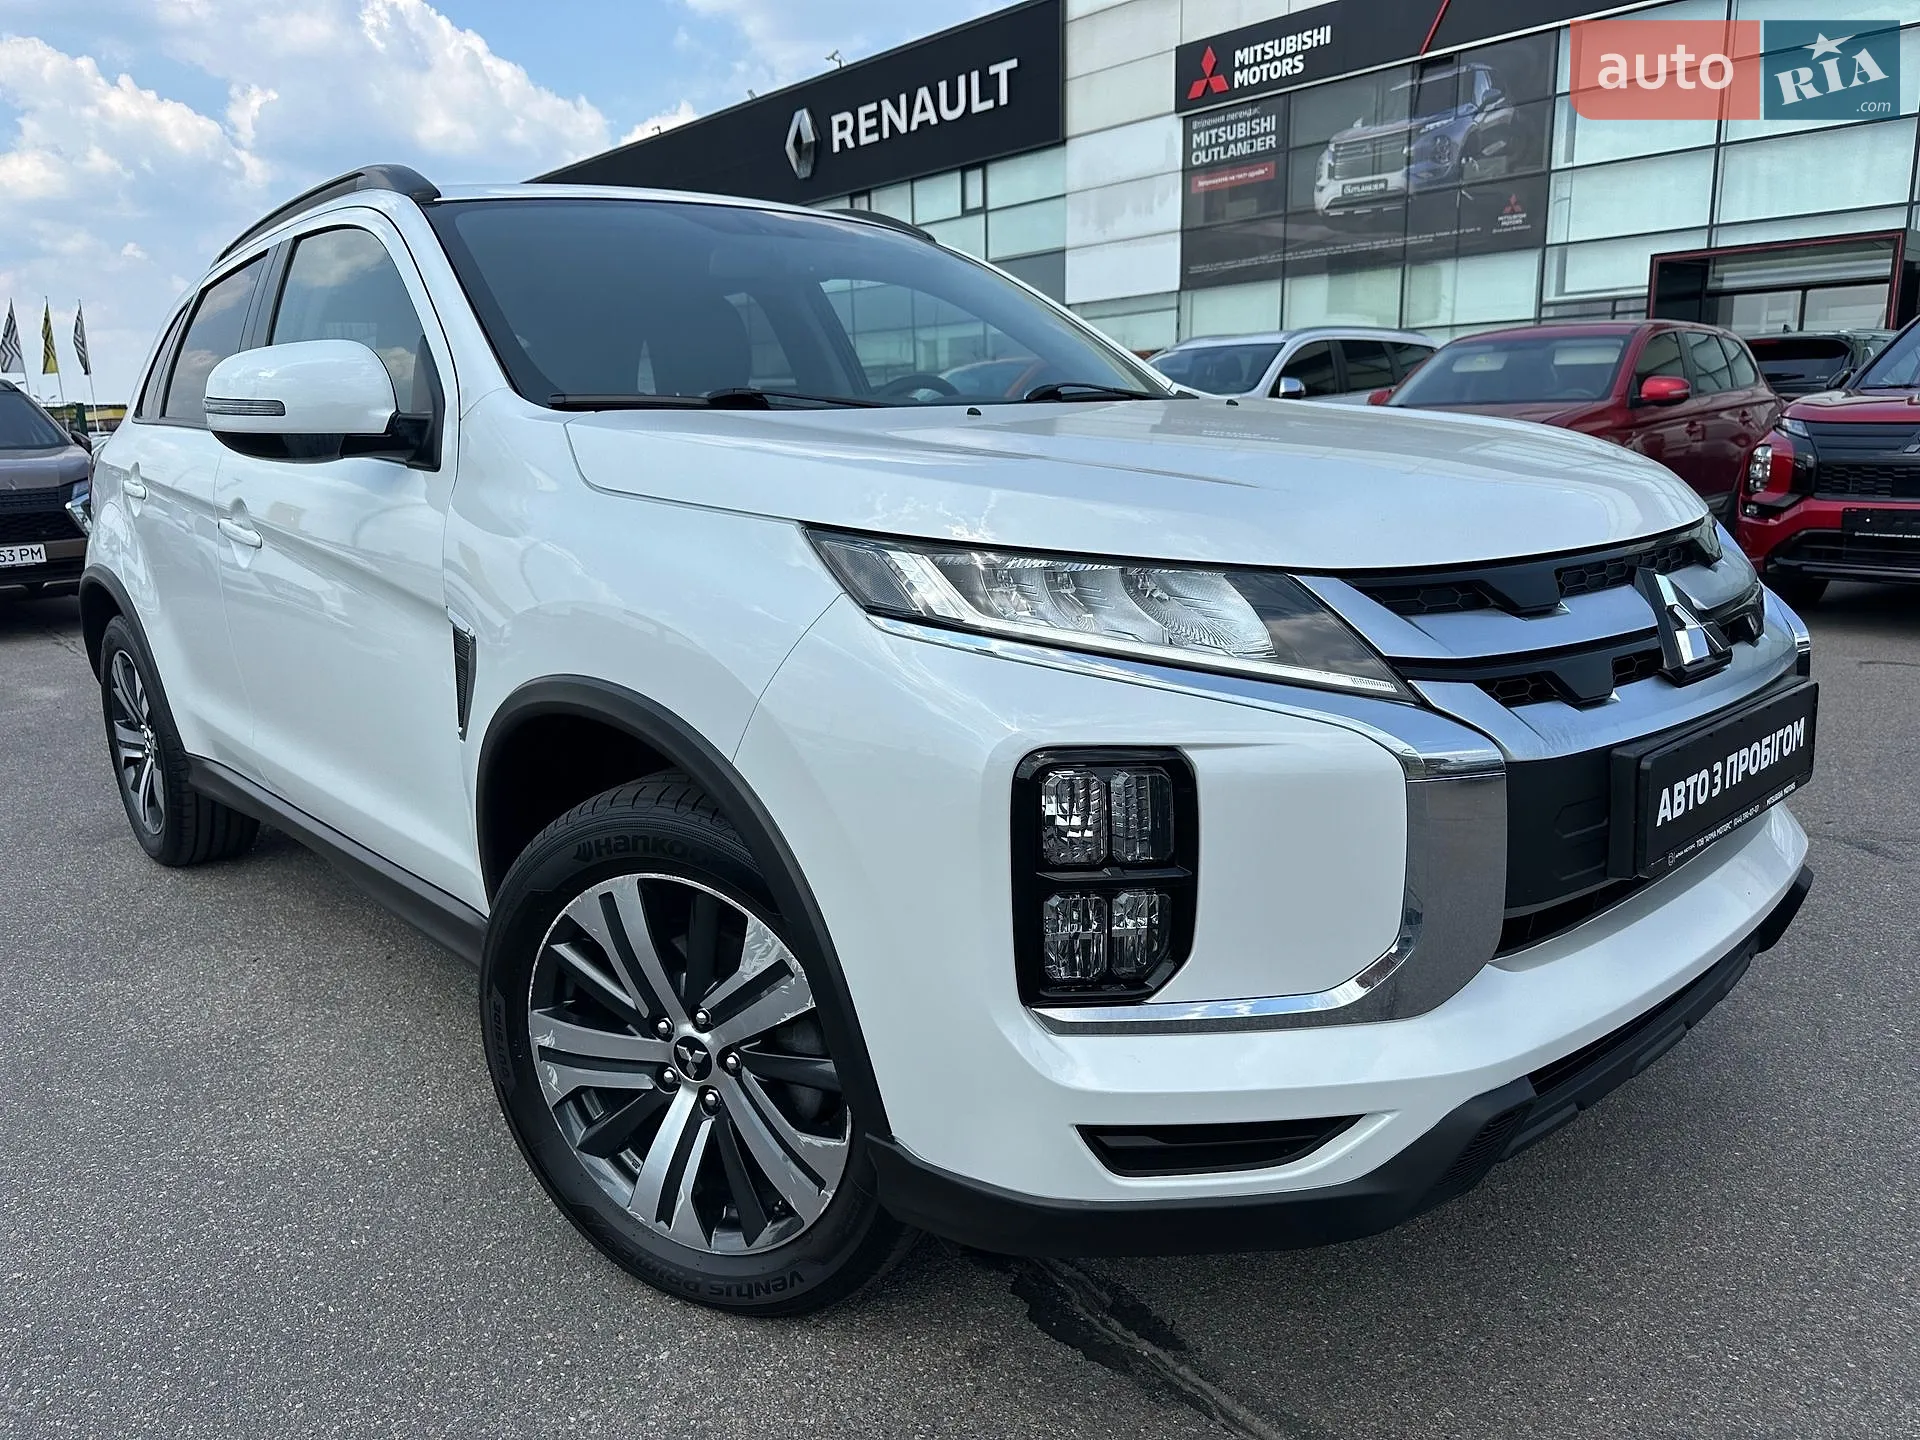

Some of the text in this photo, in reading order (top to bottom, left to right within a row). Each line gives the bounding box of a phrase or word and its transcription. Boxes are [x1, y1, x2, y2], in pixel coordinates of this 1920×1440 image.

[1234, 25, 1331, 68] MITSUBISHI
[1234, 54, 1304, 89] MOTORS
[831, 58, 1018, 153] RENAULT
[1192, 114, 1276, 149] MITSUBISHI
[1191, 134, 1276, 166] OUTLANDER
[19, 547, 42, 561] PM
[1656, 769, 1709, 827] АВТО
[1725, 717, 1805, 789] ПРОБІГОМ
